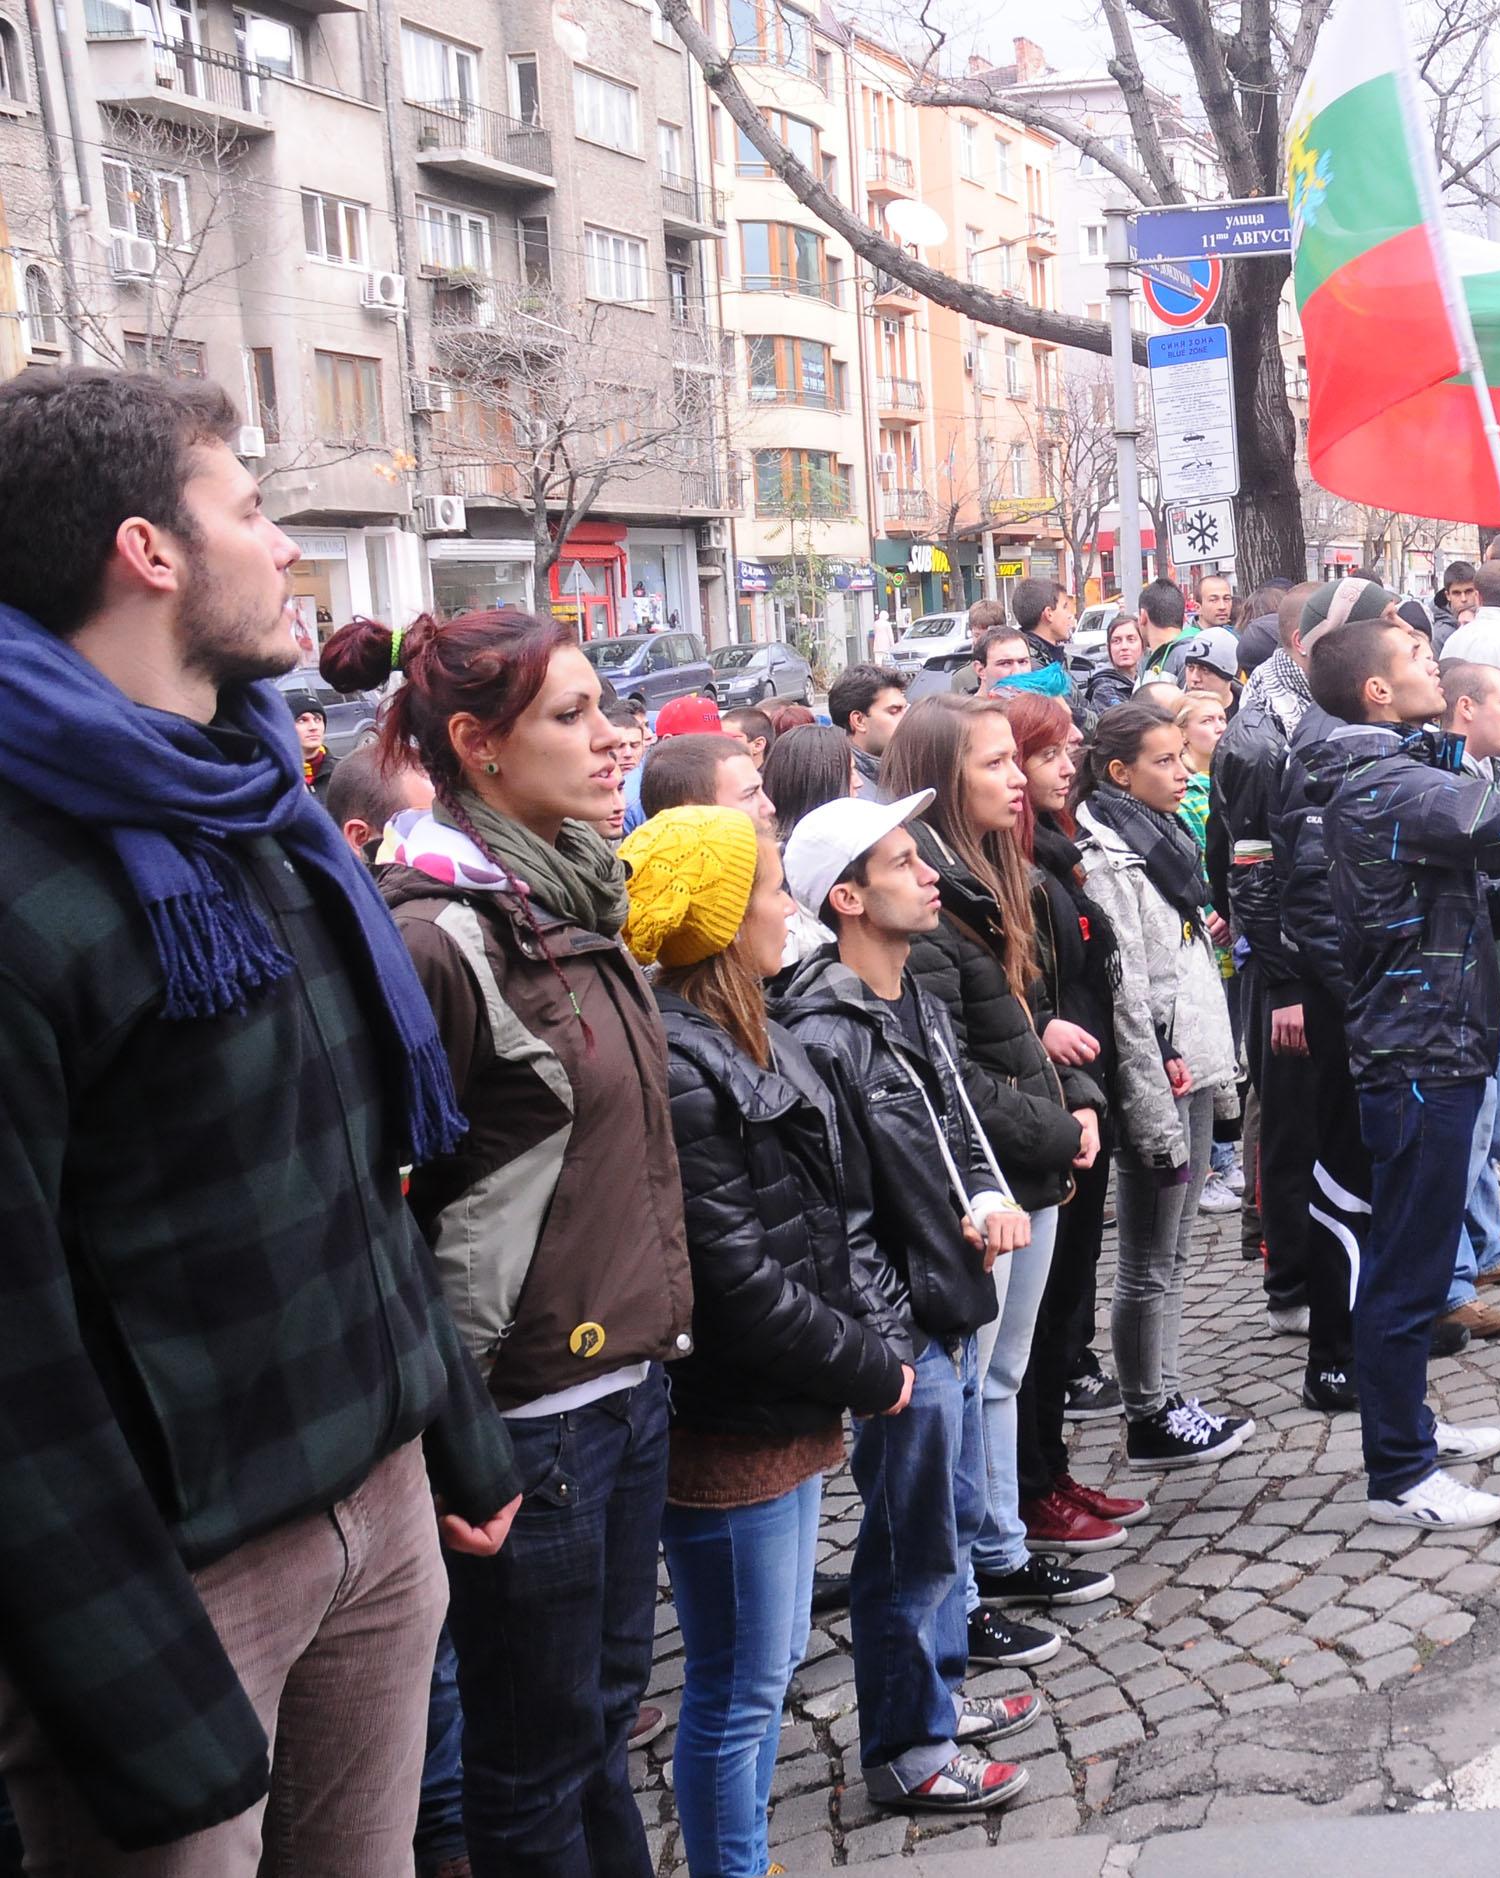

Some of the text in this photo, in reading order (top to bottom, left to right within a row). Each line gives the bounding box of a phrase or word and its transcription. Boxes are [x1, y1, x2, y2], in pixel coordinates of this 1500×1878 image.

[1225, 213, 1265, 229] улица
[1232, 228, 1291, 246] АВГУСТ
[1189, 337, 1214, 346] ЗОНА
[1167, 346, 1208, 358] BLUE ZONE
[907, 545, 951, 573] SUBWA
[1320, 1371, 1347, 1383] FILA
